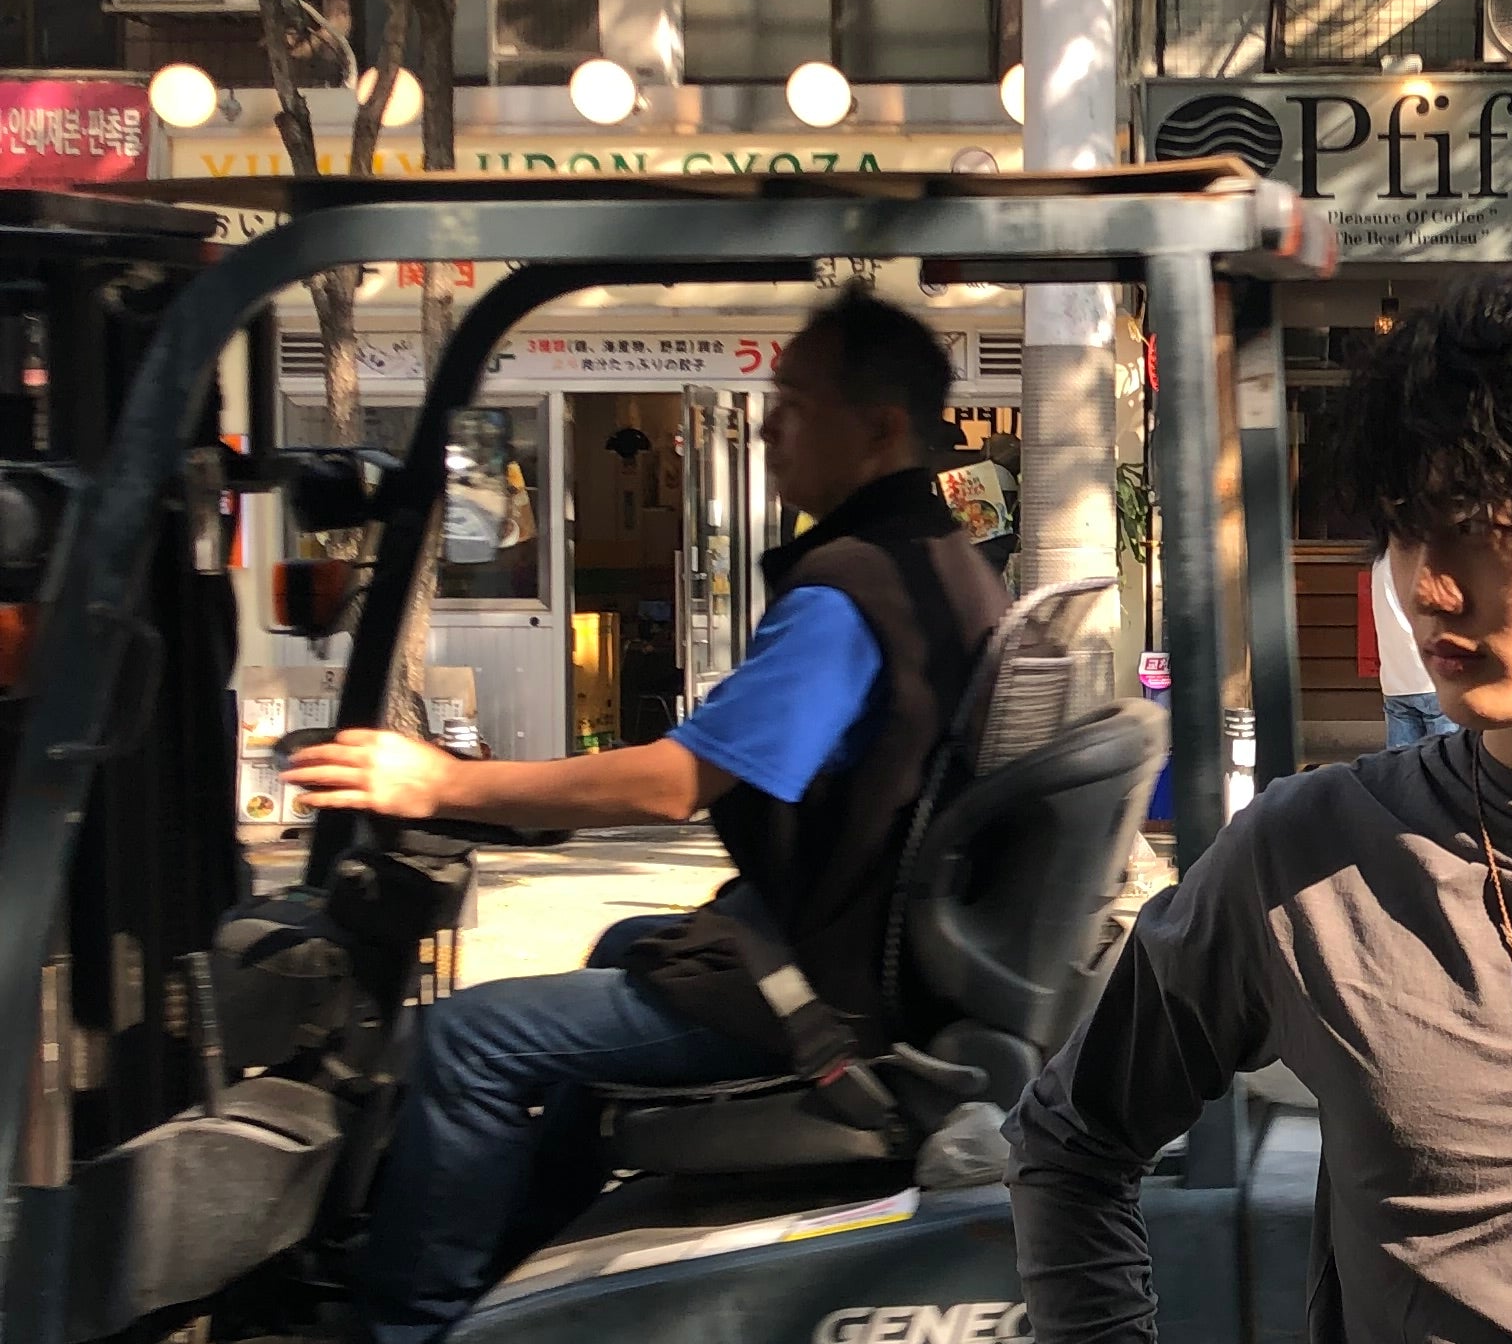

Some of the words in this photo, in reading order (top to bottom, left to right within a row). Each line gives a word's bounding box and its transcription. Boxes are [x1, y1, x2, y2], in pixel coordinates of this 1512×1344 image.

[1328, 210, 1400, 225] Pleasure
[1406, 208, 1426, 224] Of
[1366, 231, 1400, 245] Best
